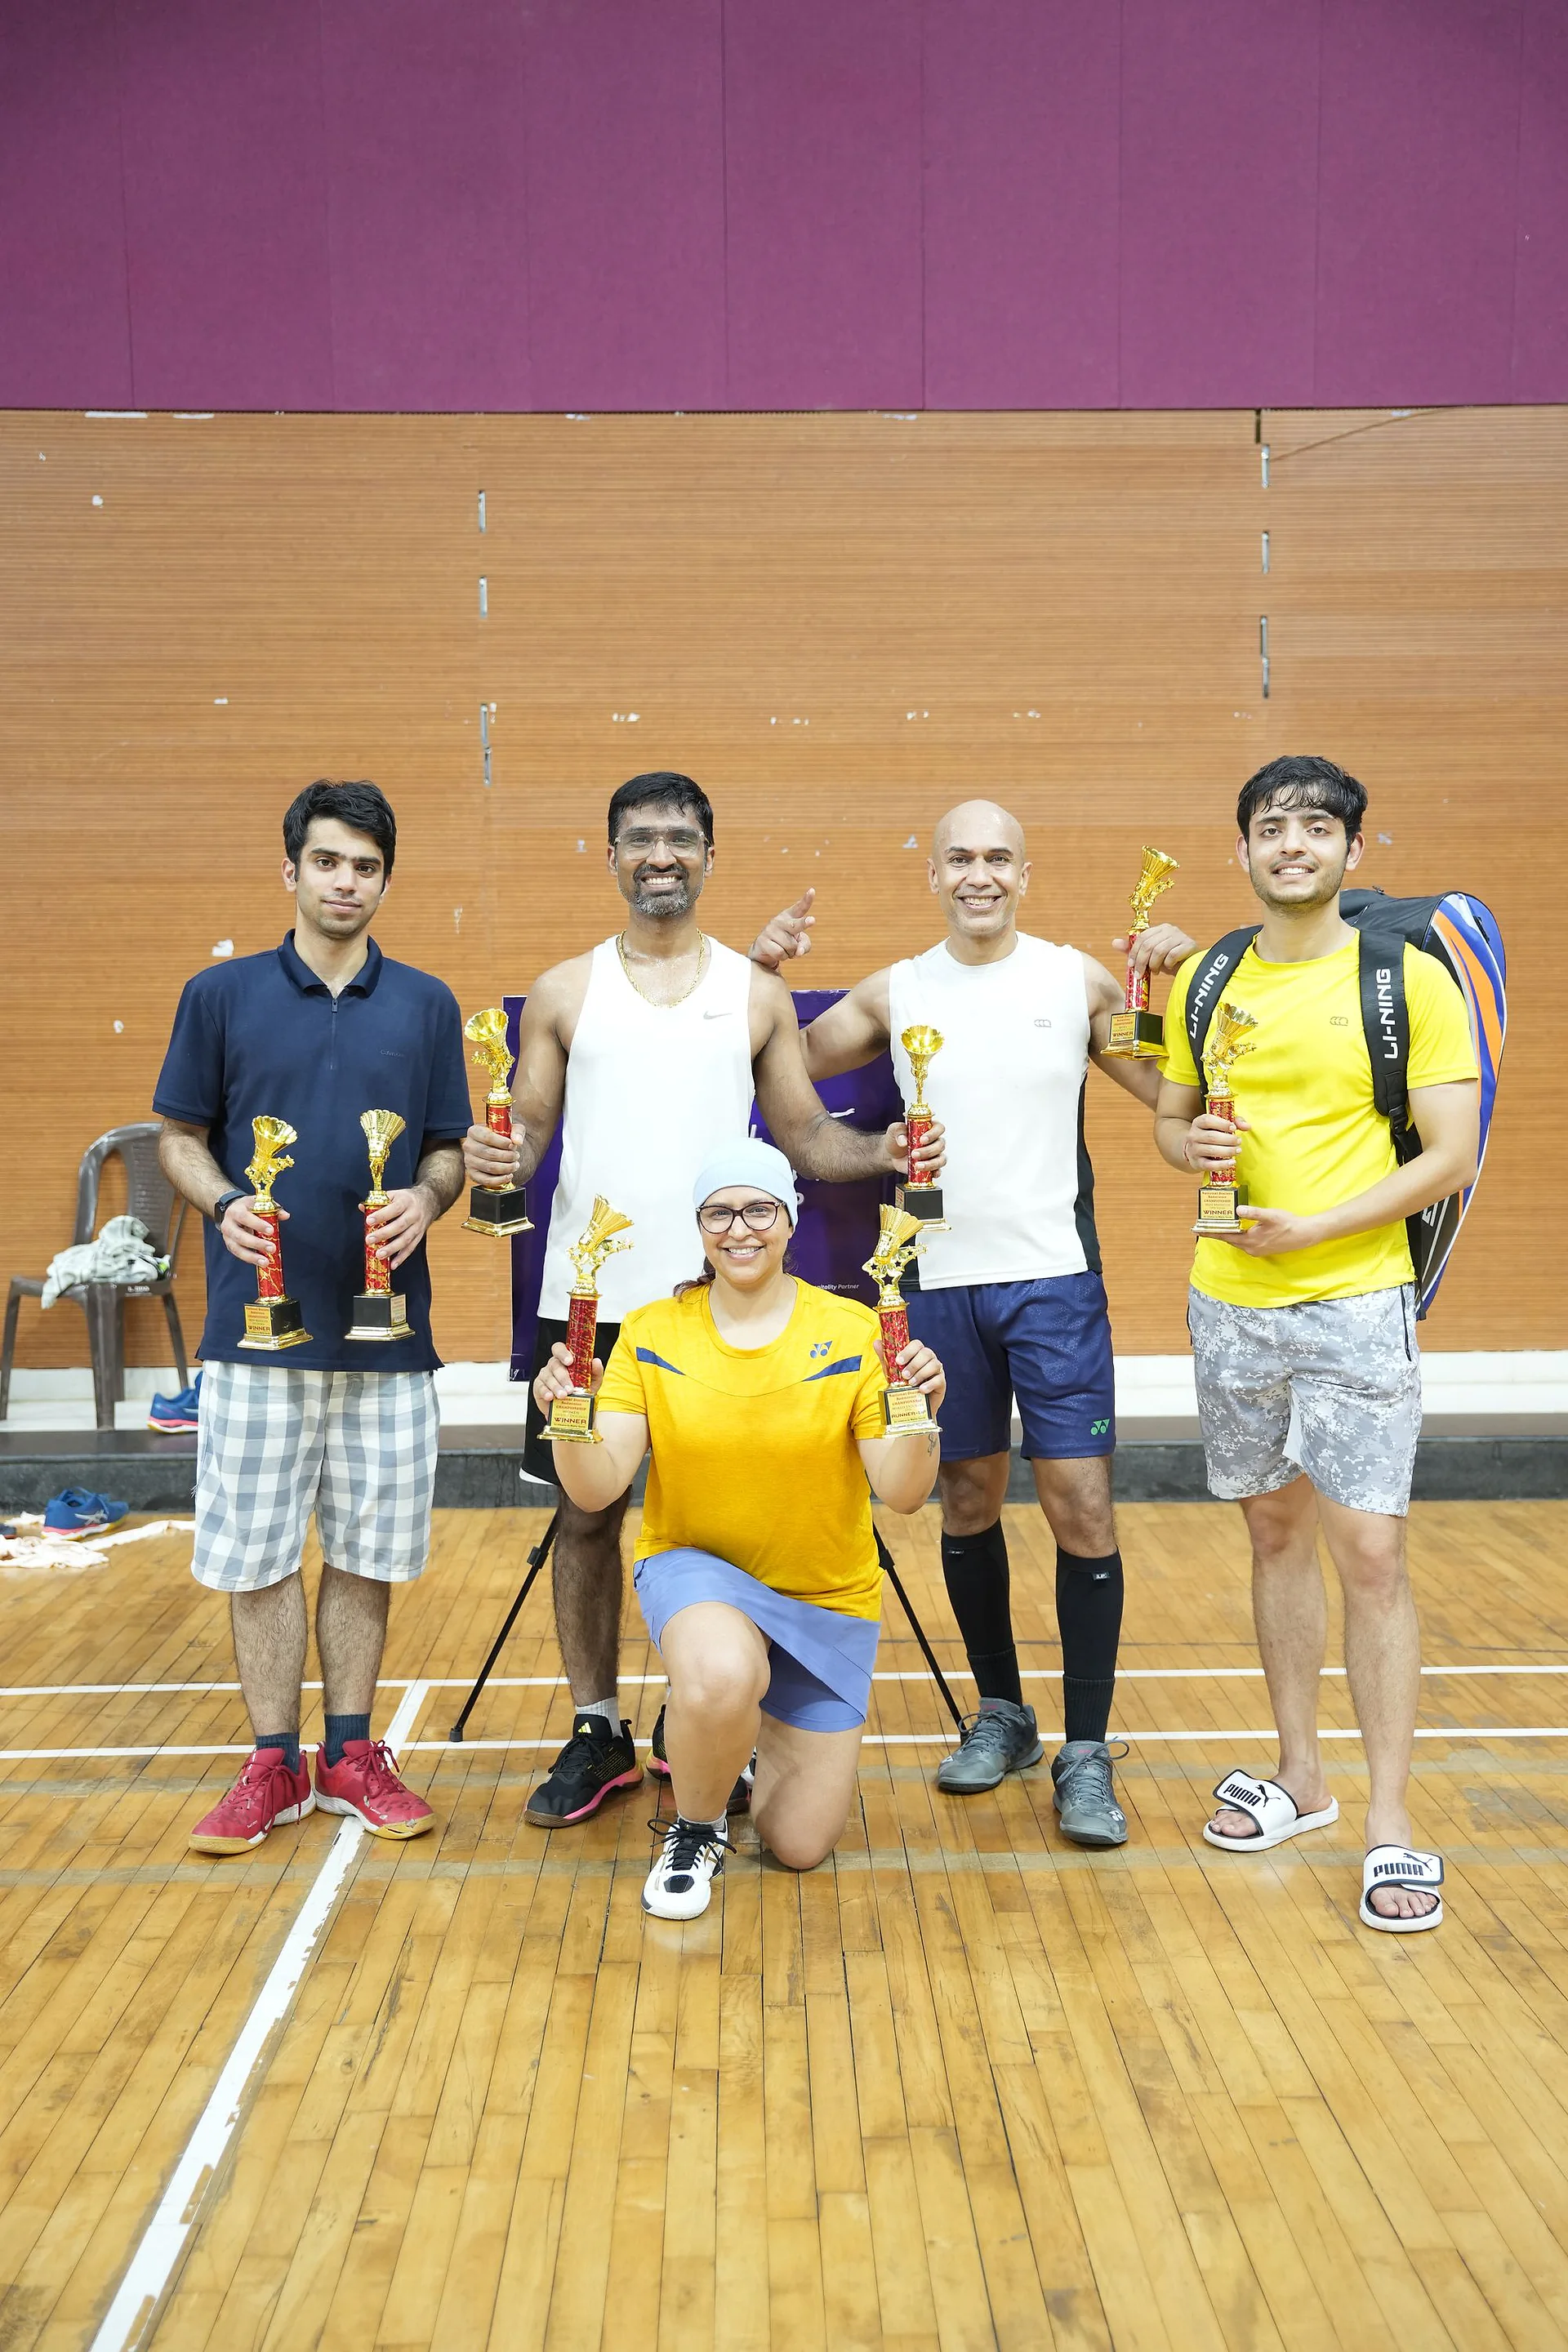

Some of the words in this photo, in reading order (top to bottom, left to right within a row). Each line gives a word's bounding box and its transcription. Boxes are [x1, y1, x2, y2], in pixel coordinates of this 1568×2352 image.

[1189, 953, 1229, 1039] LI-NING
[1376, 969, 1399, 1059] LI-NING
[1223, 1784, 1262, 1806] PUMA
[1374, 1863, 1423, 1878] PUMA
